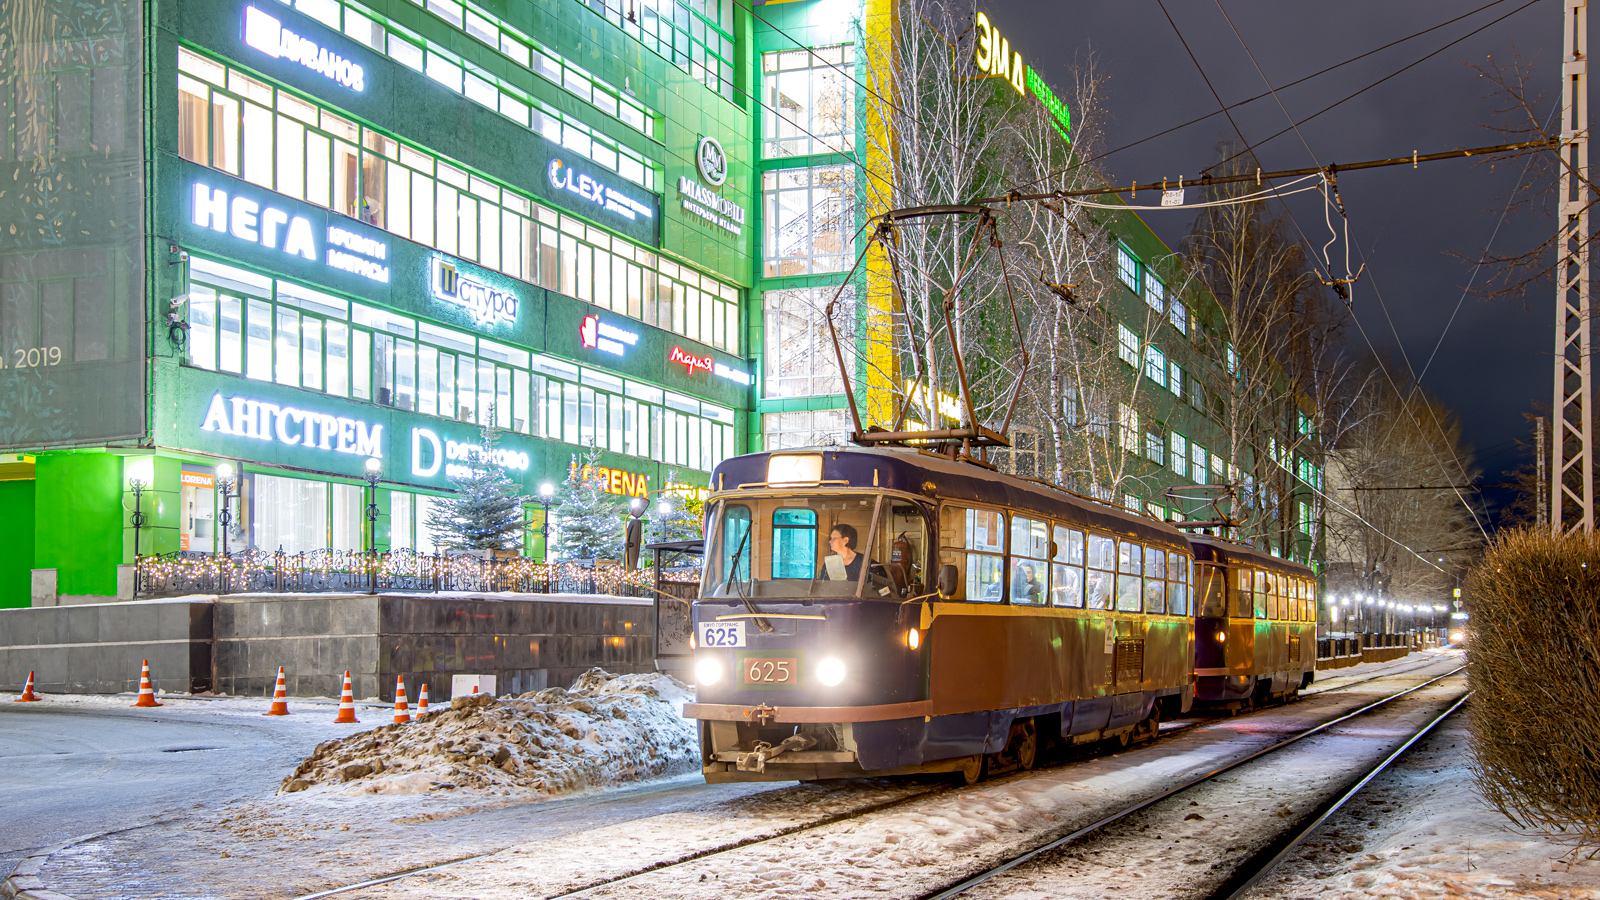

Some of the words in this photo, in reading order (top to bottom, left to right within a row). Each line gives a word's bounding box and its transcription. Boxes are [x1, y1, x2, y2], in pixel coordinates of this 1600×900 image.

[279, 28, 365, 92] ДИВАНОВ
[679, 175, 745, 225] MIASSMOBILI
[191, 182, 317, 261] НЕГА
[15, 346, 62, 369] 2019
[669, 346, 713, 375] Мария
[200, 393, 383, 458] АНГСТРЕМ
[181, 474, 213, 486] LORENA
[705, 628, 738, 646] 625
[750, 661, 790, 682] 625
